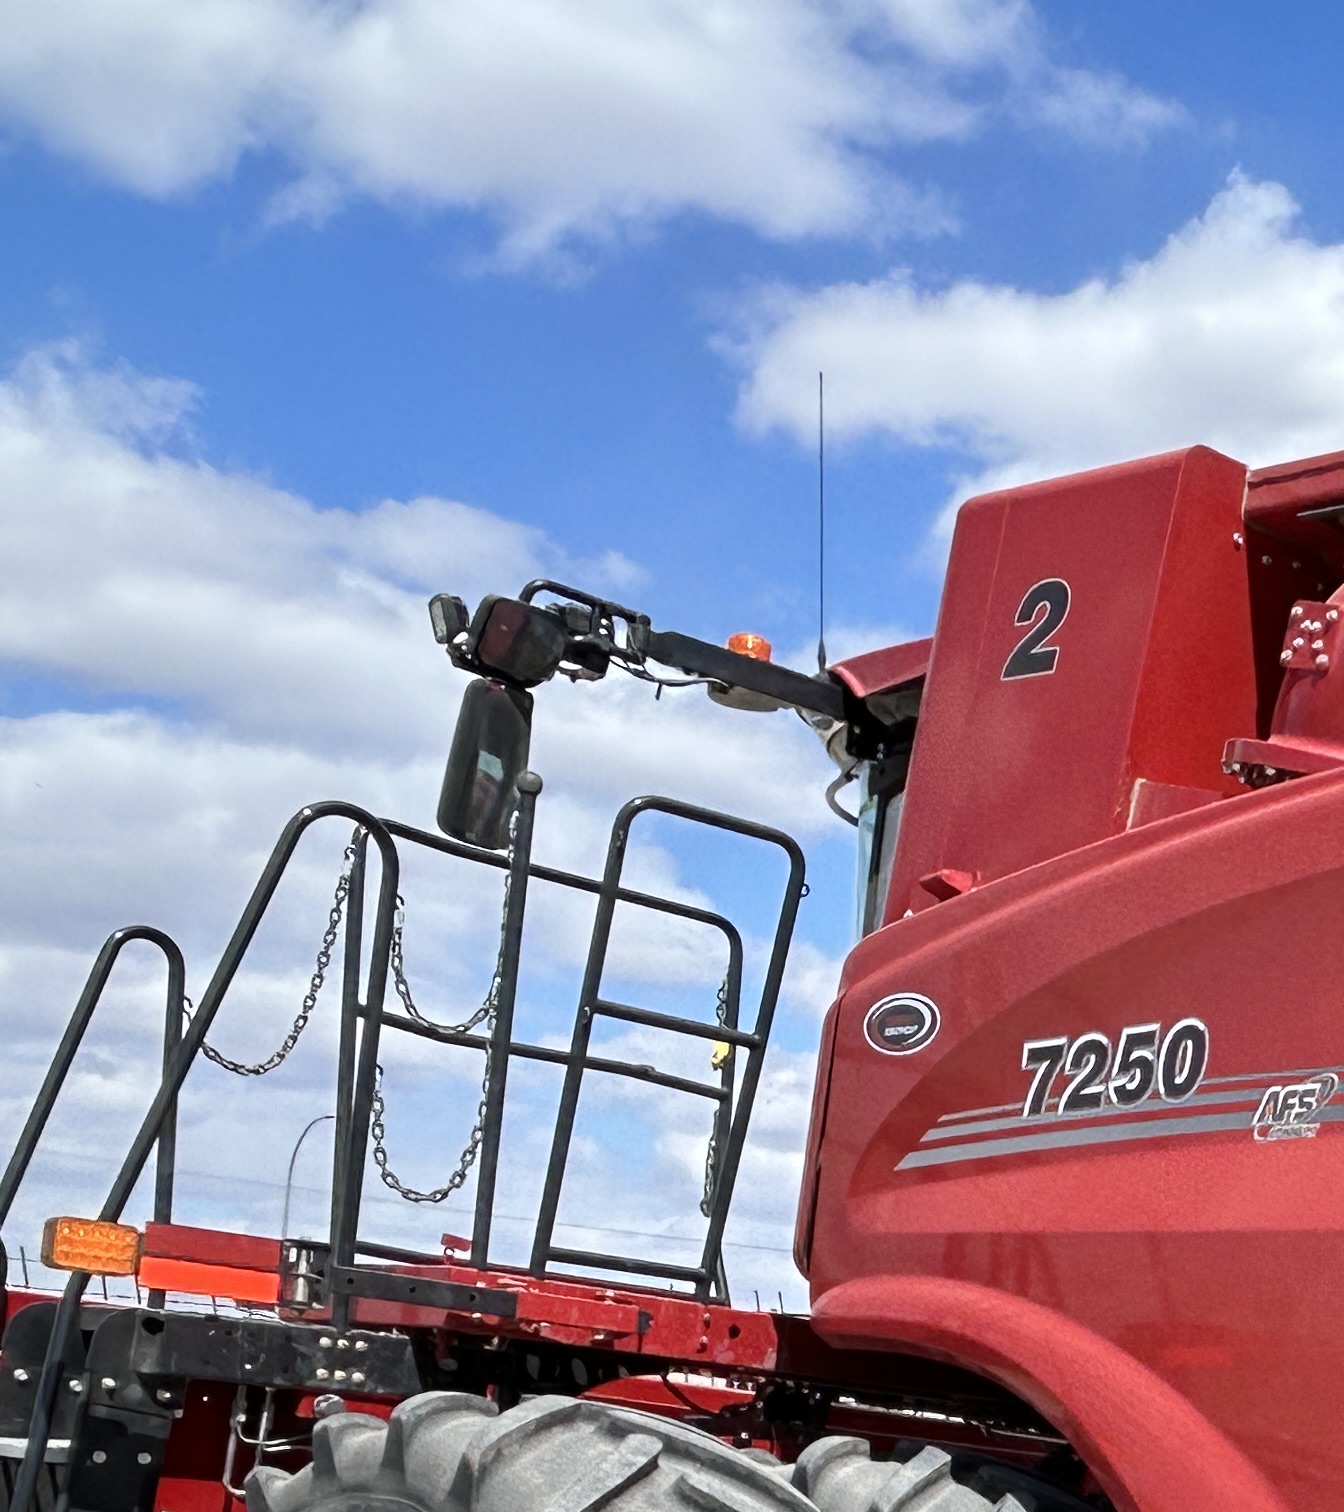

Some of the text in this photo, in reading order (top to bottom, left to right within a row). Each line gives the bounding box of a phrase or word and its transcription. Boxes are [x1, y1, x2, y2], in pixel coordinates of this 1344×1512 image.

[1000, 578, 1071, 680] 2
[1021, 1017, 1209, 1118] 7250
[1251, 1083, 1321, 1126] AFS
